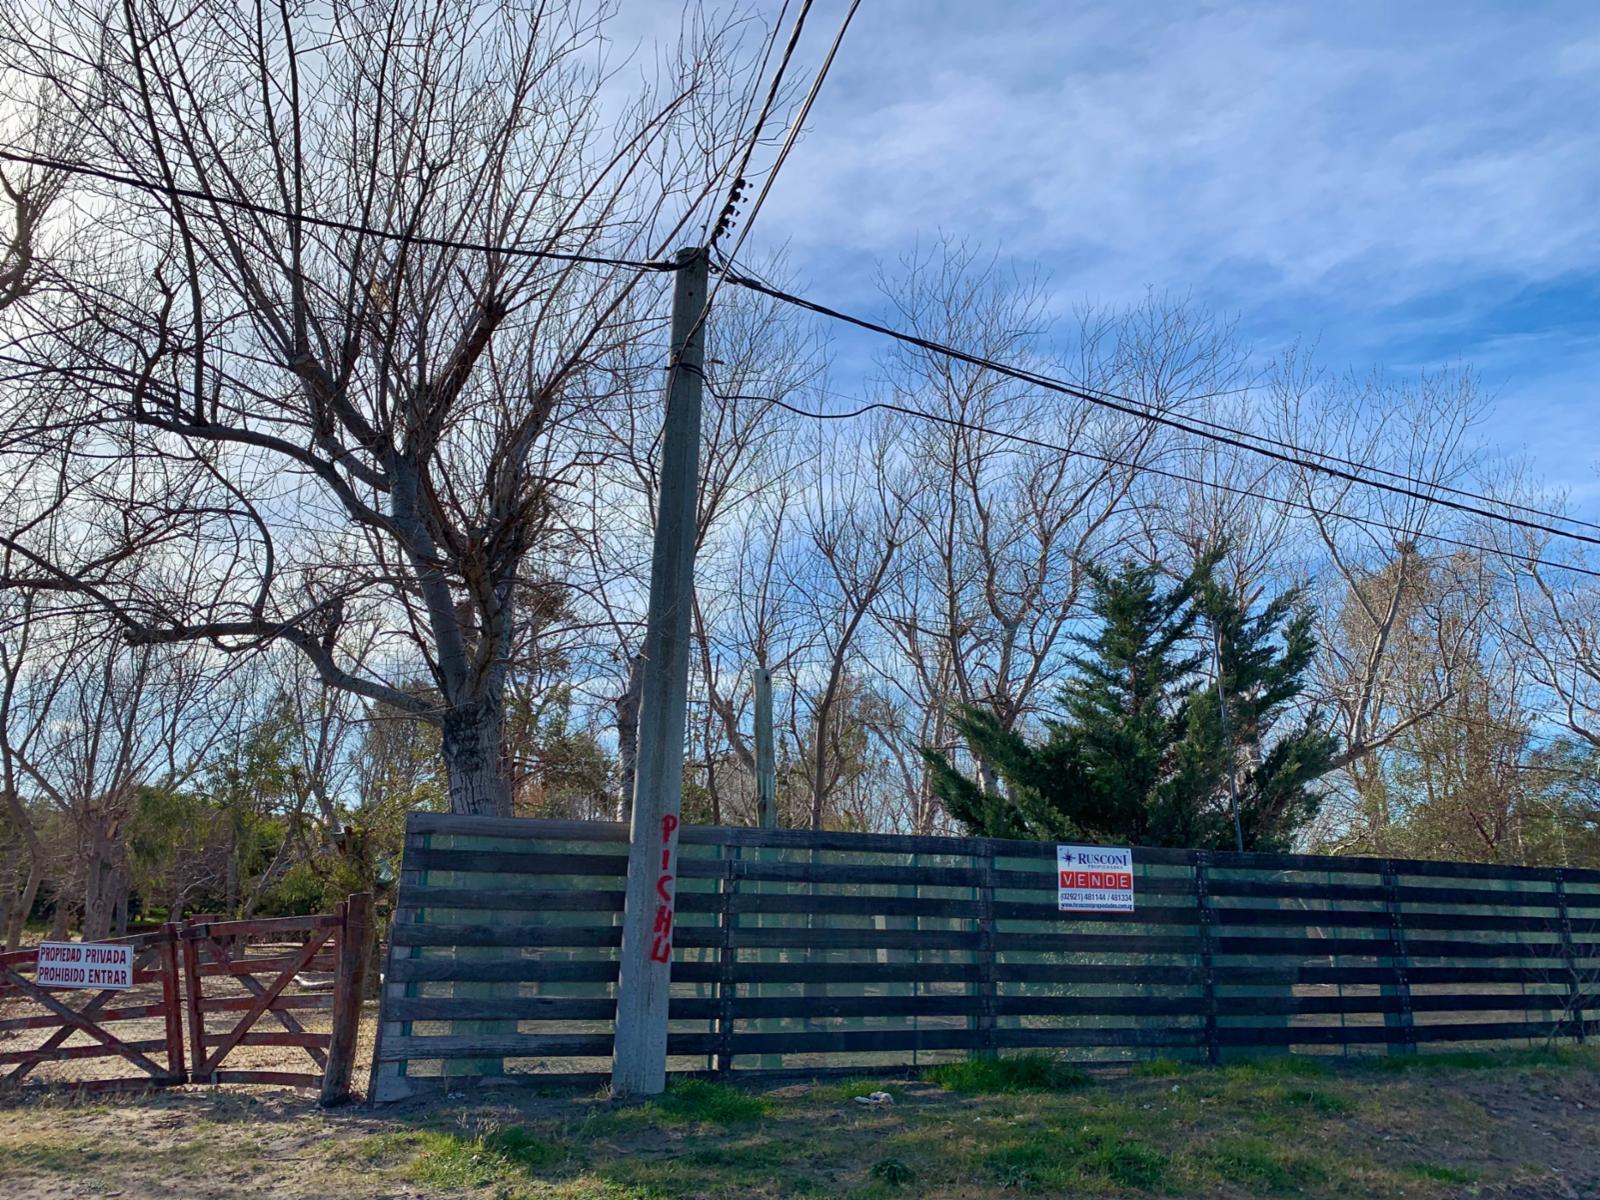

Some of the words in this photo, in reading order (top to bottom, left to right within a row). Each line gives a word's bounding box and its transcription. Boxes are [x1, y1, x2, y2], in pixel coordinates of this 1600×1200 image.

[1078, 853, 1127, 866] RUSCONI
[651, 814, 678, 963] PICHU
[1063, 873, 1128, 888] VENDE
[40, 947, 82, 962] PROPIEDAD
[85, 948, 126, 964] PRIVADA
[39, 967, 85, 983] PROHIBIDO
[88, 969, 127, 985] ENTRAR
